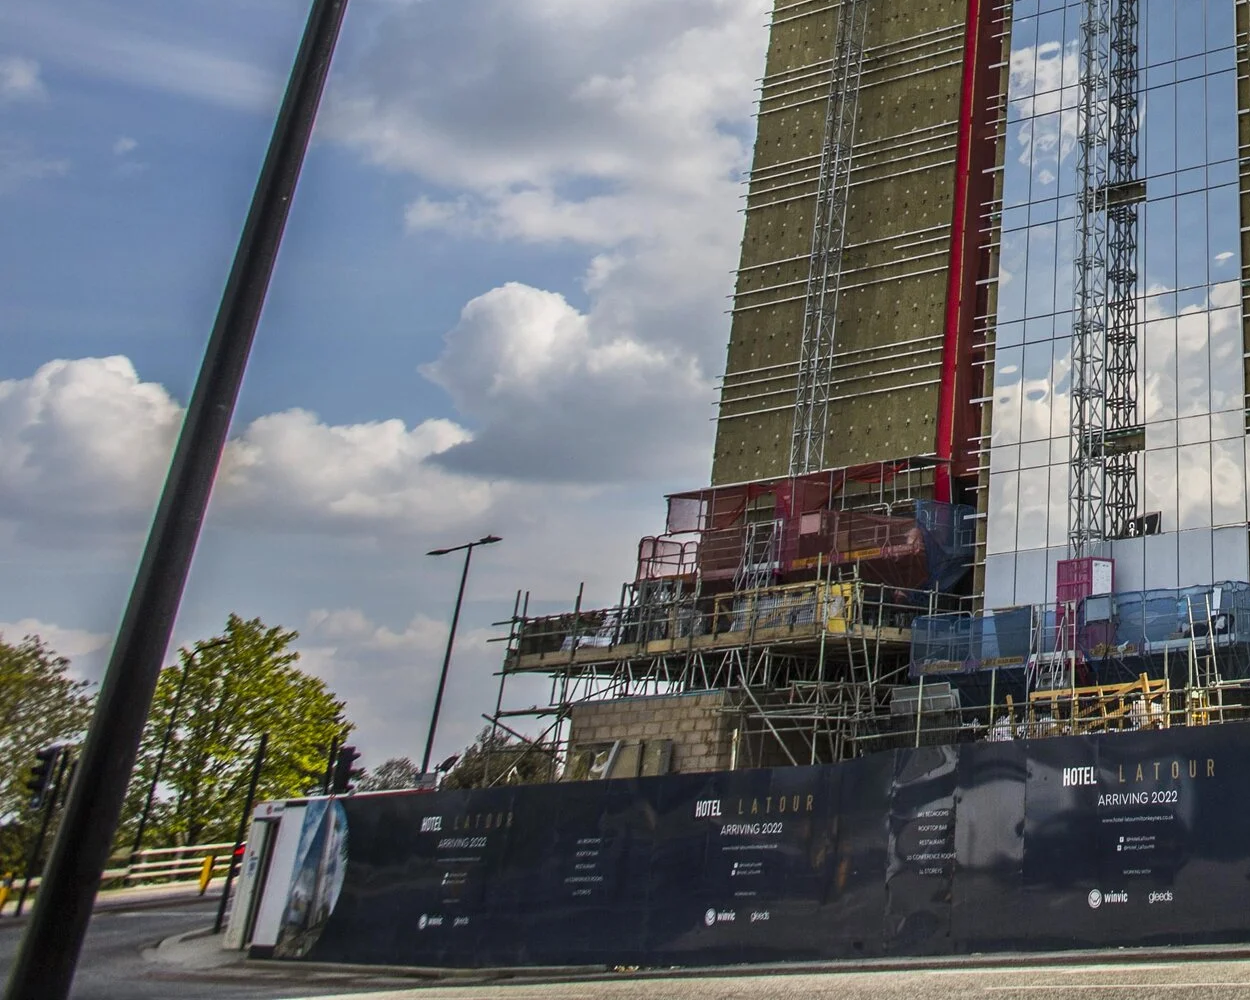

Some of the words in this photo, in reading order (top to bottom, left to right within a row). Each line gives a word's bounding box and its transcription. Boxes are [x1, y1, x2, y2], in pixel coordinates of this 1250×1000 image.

[1063, 766, 1097, 787] HOTEL
[1119, 759, 1215, 782] LATOUR
[695, 800, 721, 817] HOTEL
[738, 794, 813, 814] LATOUR
[1098, 792, 1148, 806] ARRIVING
[1151, 790, 1178, 803] 2022
[420, 816, 442, 832] HOTEL
[720, 823, 760, 835] ARRIVING
[761, 822, 783, 834] 2022
[438, 838, 469, 848] ARRIVING
[469, 836, 487, 847] 2022
[1104, 889, 1128, 903] winvic
[1149, 891, 1173, 904] gleeds
[717, 910, 735, 921] winvic
[751, 910, 770, 922] gleeds
